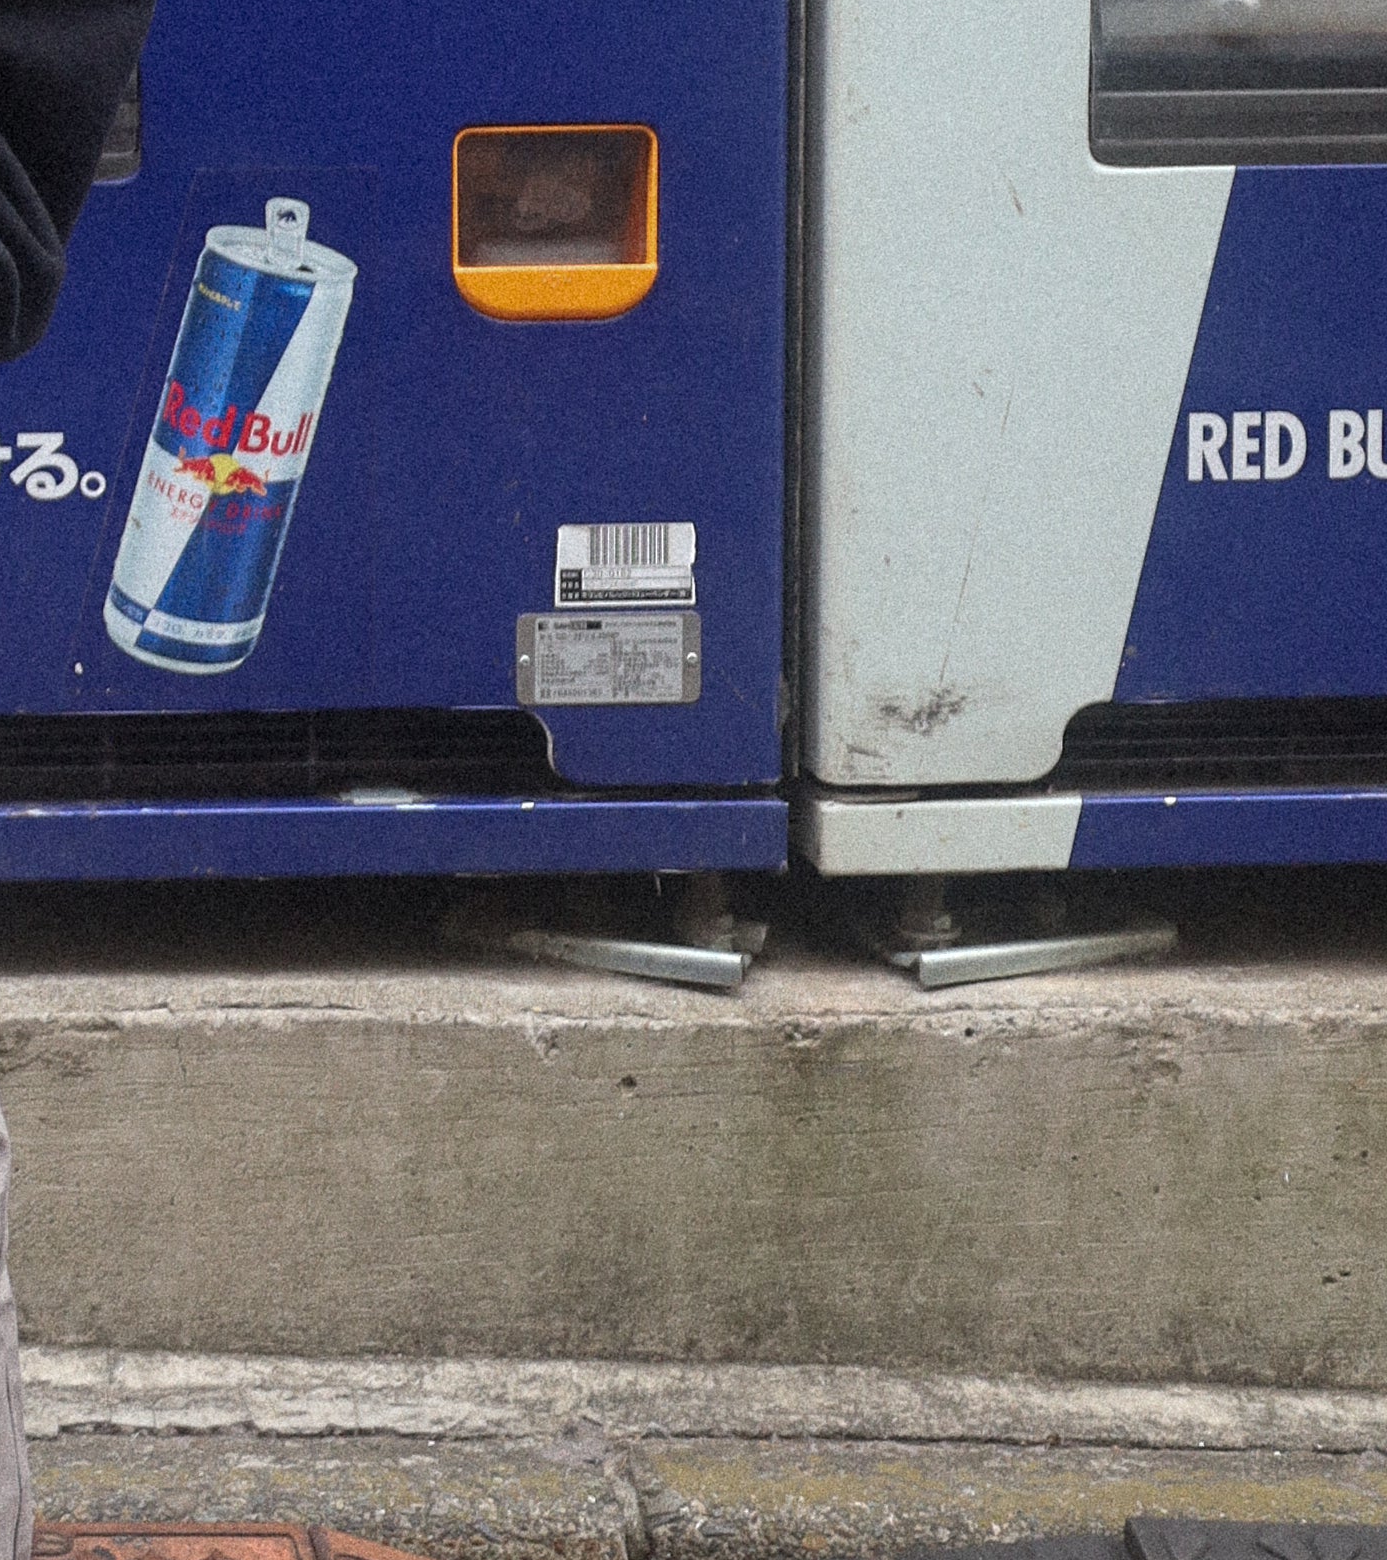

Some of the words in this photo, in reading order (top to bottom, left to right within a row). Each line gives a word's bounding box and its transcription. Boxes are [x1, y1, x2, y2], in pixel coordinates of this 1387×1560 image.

[161, 379, 238, 449] Red
[238, 410, 315, 457] Bull
[1187, 410, 1308, 482] RED
